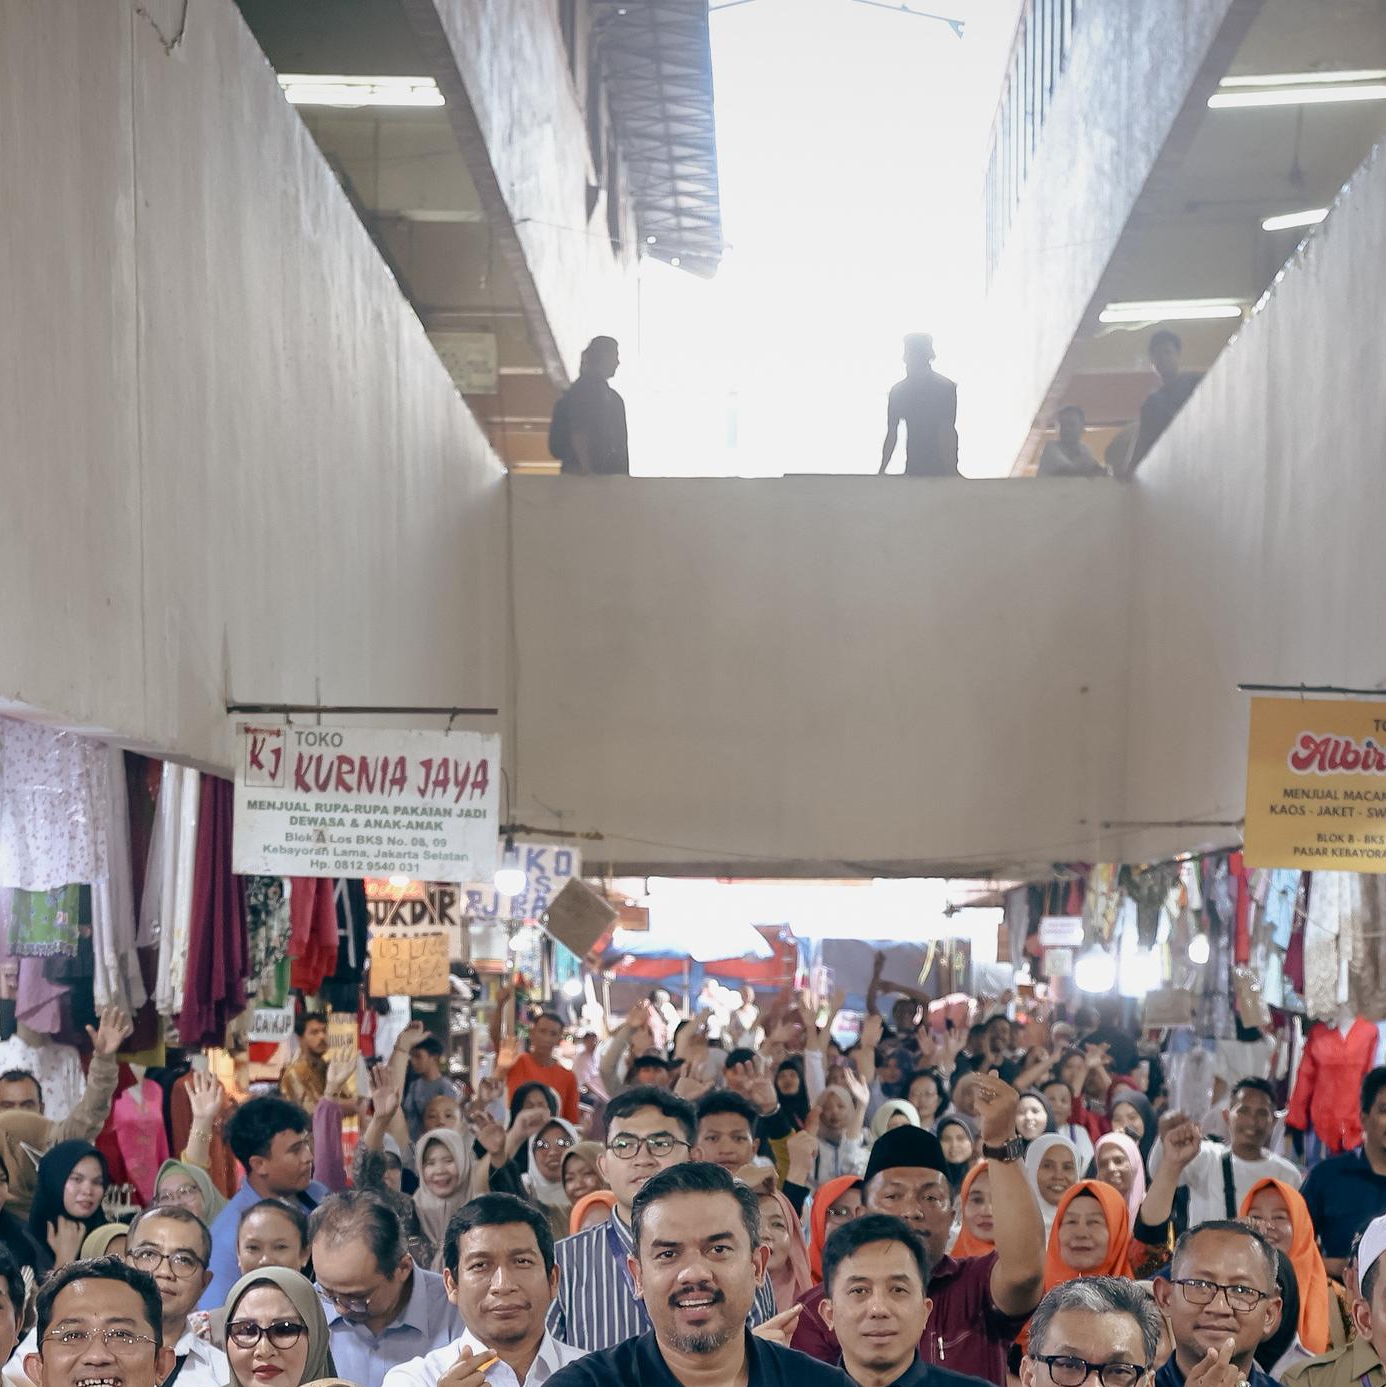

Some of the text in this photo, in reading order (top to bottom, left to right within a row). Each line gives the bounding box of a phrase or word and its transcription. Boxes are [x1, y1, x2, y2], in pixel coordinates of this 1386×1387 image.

[295, 731, 344, 747] TOKO
[295, 752, 409, 797] KURNIA
[417, 757, 489, 804] JAYA
[1283, 788, 1339, 800] MENJUAL
[247, 800, 487, 819] MENJUAL RUPA-RUPA PAKAIAN JADI
[1269, 805, 1306, 816] KAOS
[1317, 806, 1355, 817] JAKET
[289, 816, 443, 831] DEWASA & ANAK-ANAK
[285, 832, 312, 843] Blok
[314, 831, 326, 844] A
[330, 833, 352, 844] Los
[356, 834, 383, 845] BKS
[387, 836, 407, 846] No.
[433, 838, 447, 847] 09
[1316, 833, 1344, 843] BLOK
[1364, 834, 1385, 844] BKS
[263, 845, 329, 858] Kebayoran
[374, 849, 419, 860] Jakarta
[423, 851, 469, 862] Selatan
[1293, 847, 1329, 857] PASAR
[310, 860, 420, 872] Hp. 0812 9540 031
